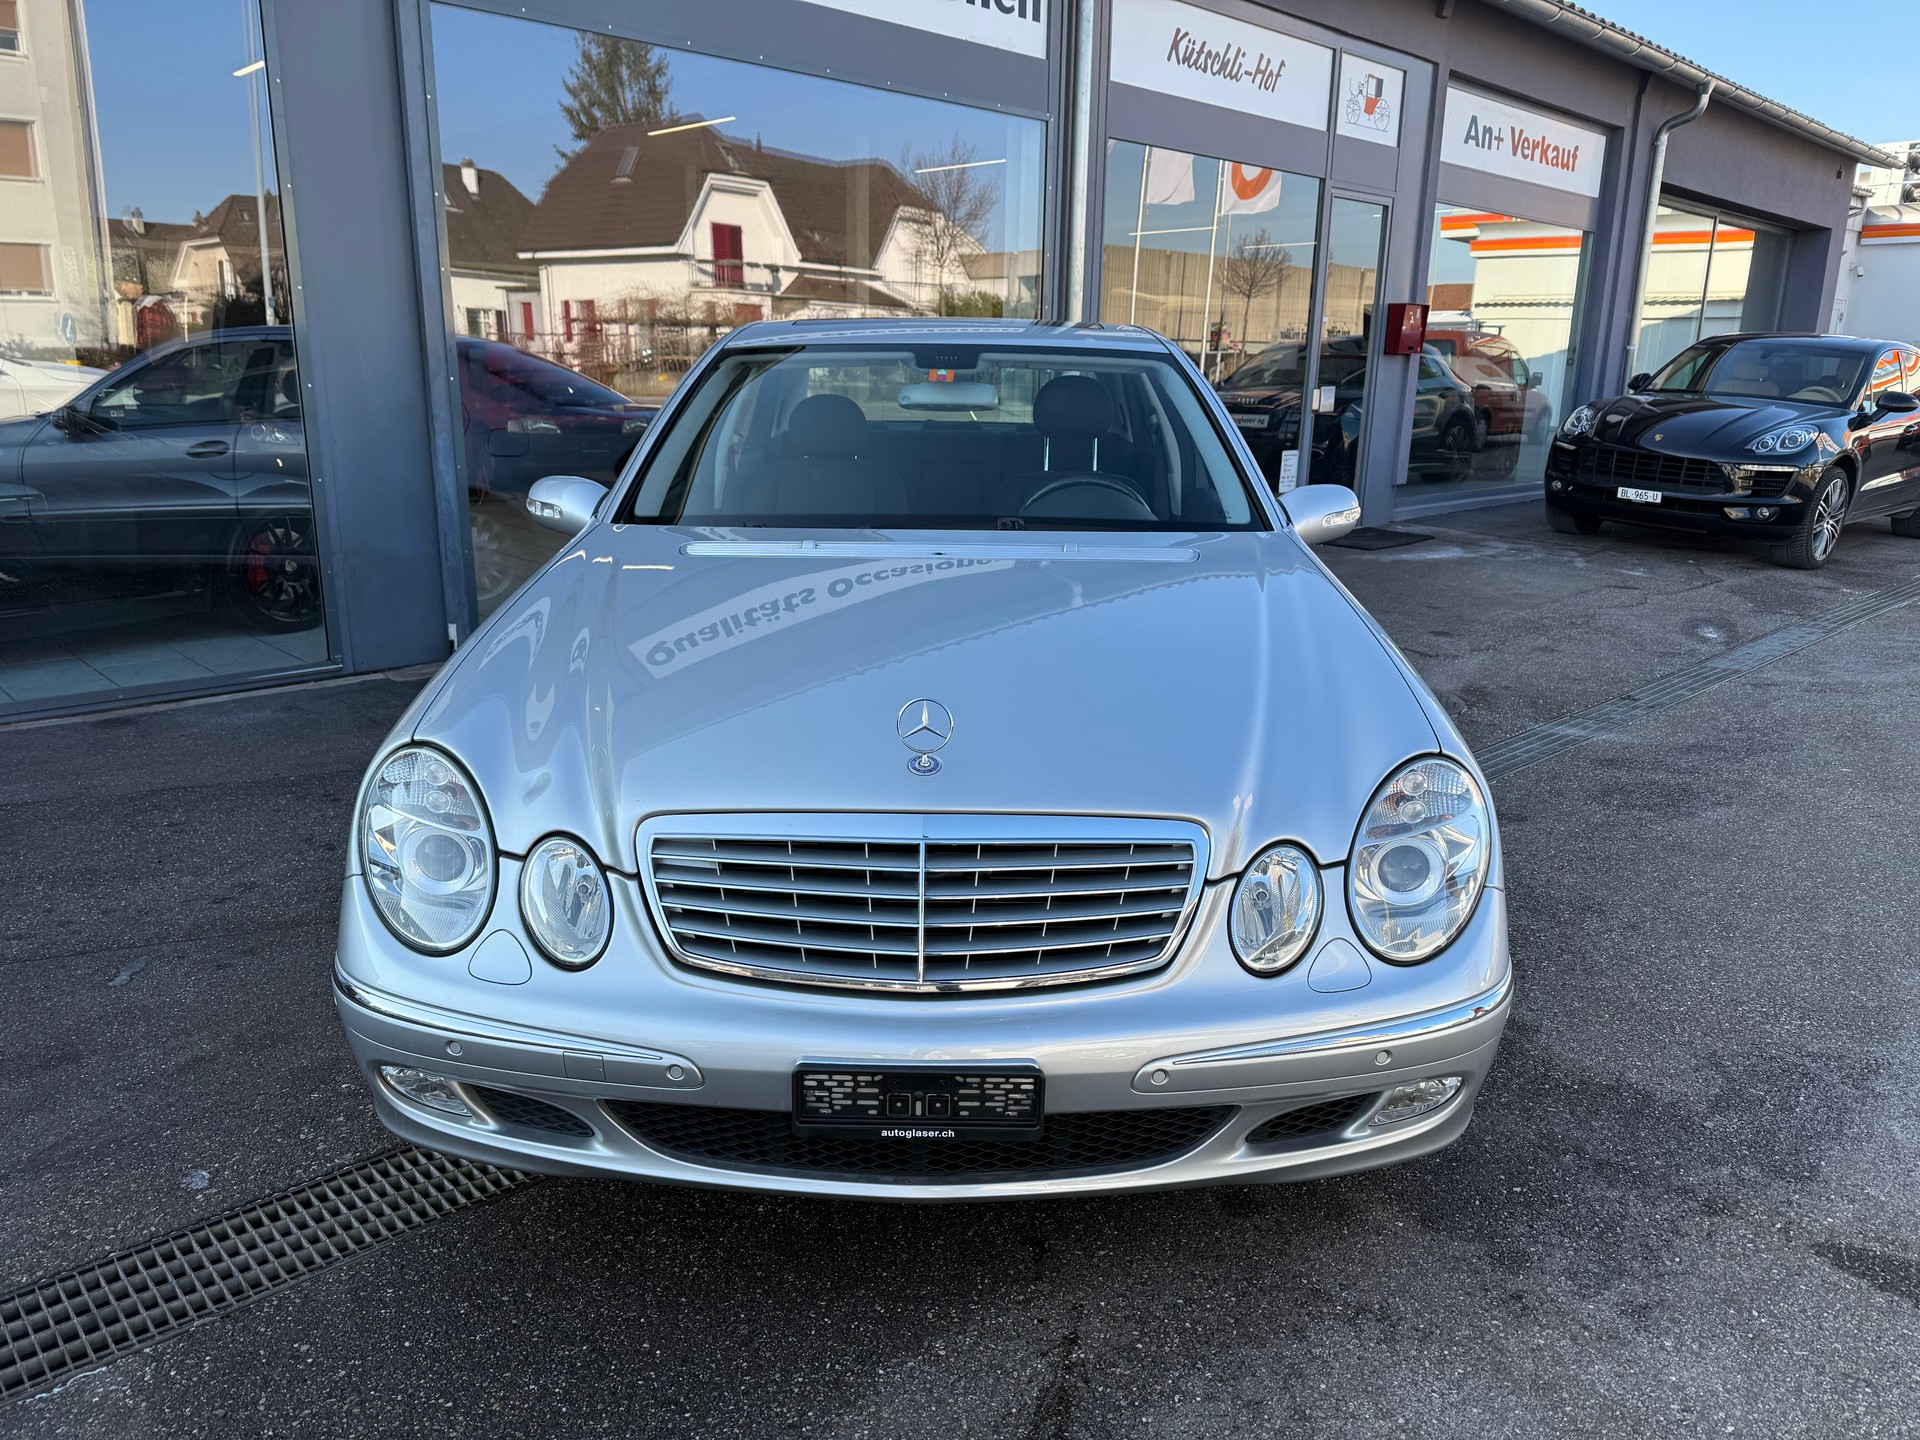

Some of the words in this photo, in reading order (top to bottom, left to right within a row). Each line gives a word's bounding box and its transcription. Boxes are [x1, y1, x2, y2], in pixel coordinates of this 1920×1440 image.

[1167, 28, 1286, 93] Kütschli-Hof
[1511, 126, 1580, 173] Verkauf
[881, 1128, 955, 1138] autoglaser.ch
